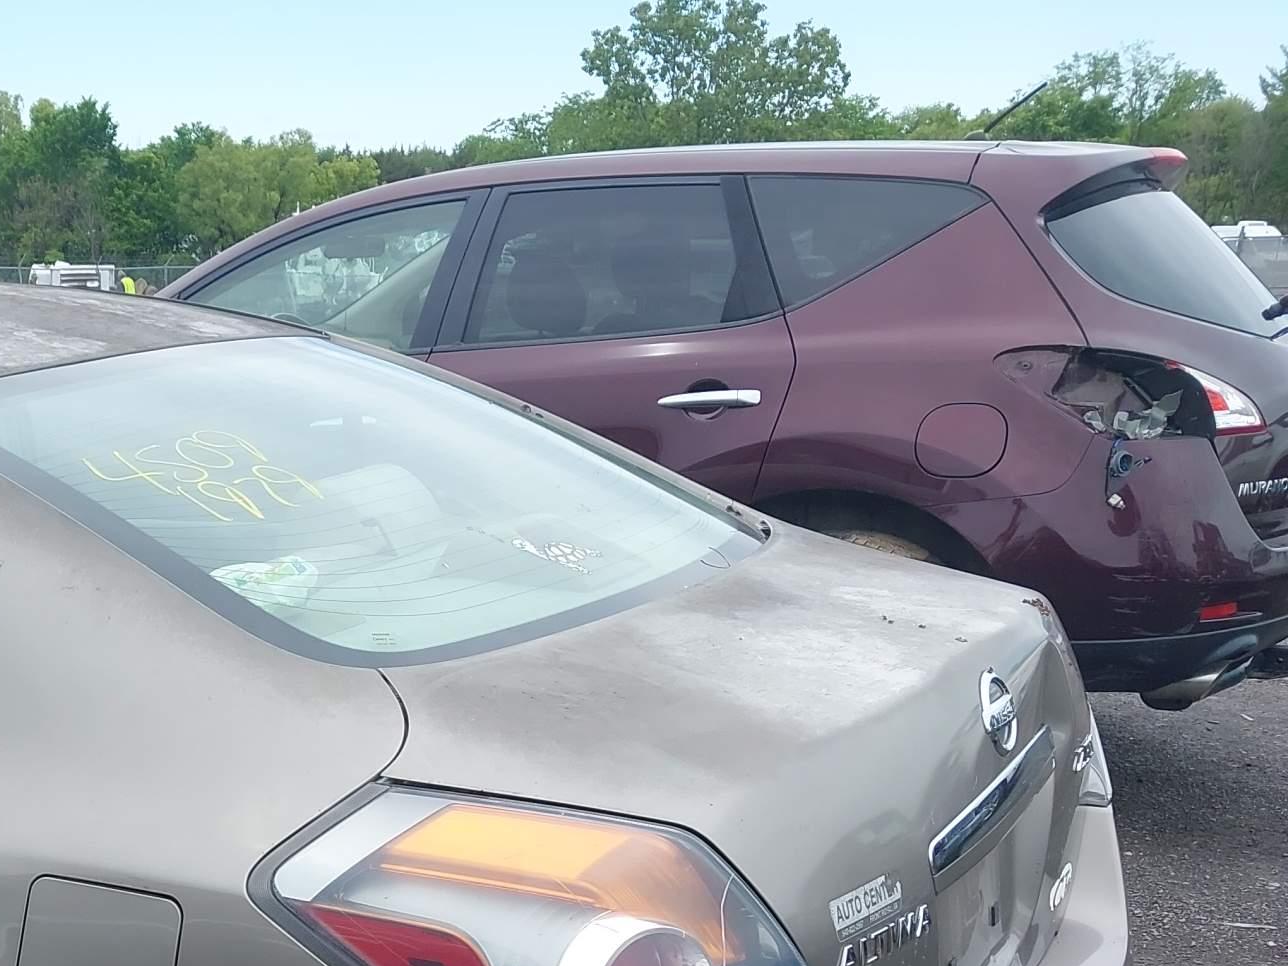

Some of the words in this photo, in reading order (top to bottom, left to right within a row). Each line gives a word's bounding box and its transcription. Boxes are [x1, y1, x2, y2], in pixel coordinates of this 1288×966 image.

[82, 430, 269, 497] 4509
[176, 465, 325, 522] 1979
[835, 895, 863, 925] AUTO
